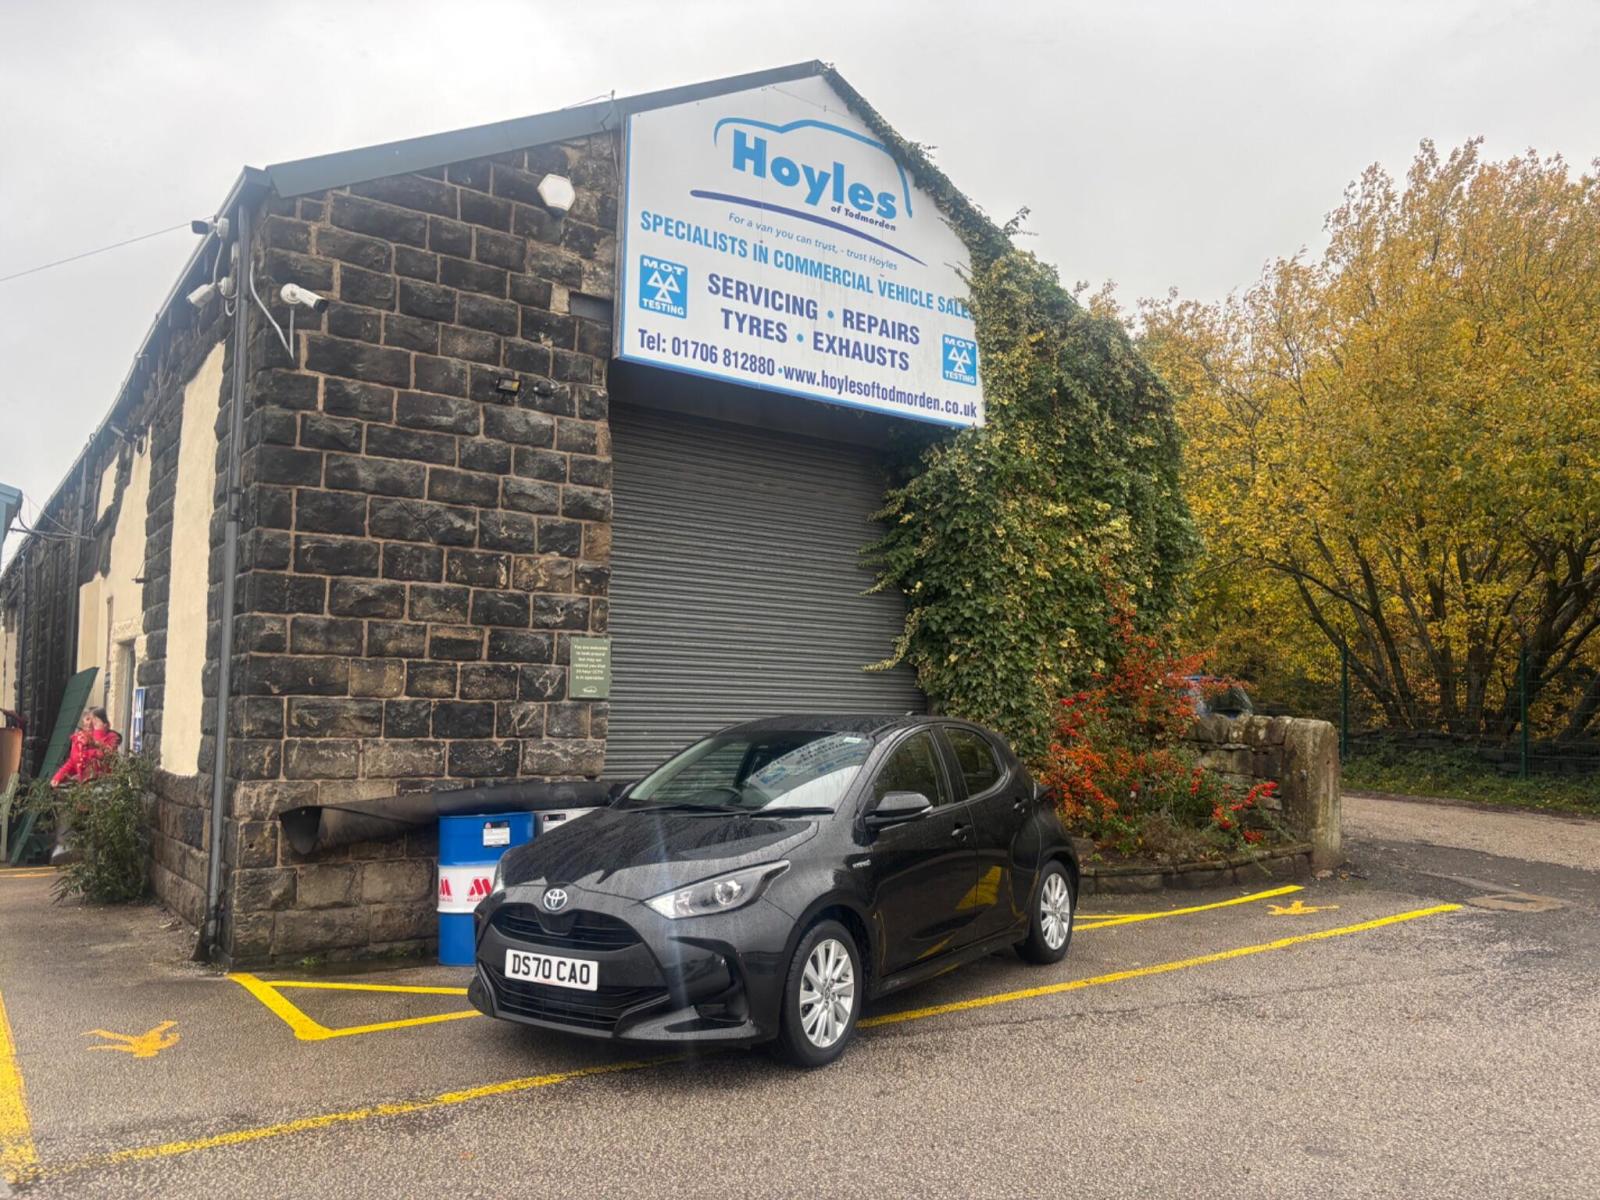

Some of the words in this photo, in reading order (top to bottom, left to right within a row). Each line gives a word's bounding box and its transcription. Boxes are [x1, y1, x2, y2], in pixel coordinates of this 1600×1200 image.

[732, 128, 897, 219] Hoyles
[728, 212, 745, 224] For
[746, 219, 753, 228] a
[755, 221, 773, 234] van
[775, 227, 794, 240] you
[796, 235, 812, 245] can
[847, 249, 867, 262] trust
[869, 255, 898, 271] Hoyles
[830, 205, 842, 214] of
[844, 208, 897, 232] Todmorden
[640, 210, 748, 259] SPECIALISTS
[753, 243, 768, 264] IN
[773, 250, 873, 294] COMMERCIAL
[878, 279, 934, 310] VEHICLE
[642, 298, 685, 316] TESTING
[707, 272, 818, 321] SERVICING
[842, 308, 920, 345] REPAIRS
[720, 308, 788, 344] TYRES
[812, 331, 910, 371] EXHAUSTS
[638, 328, 667, 353] Tel:
[671, 337, 718, 364] 01706
[723, 348, 775, 377] 812880
[783, 365, 977, 418] www.hoylesoftodmorden.co.uk
[944, 370, 976, 384] TESTING
[512, 953, 552, 980] DS70
[556, 960, 590, 985] CAO
